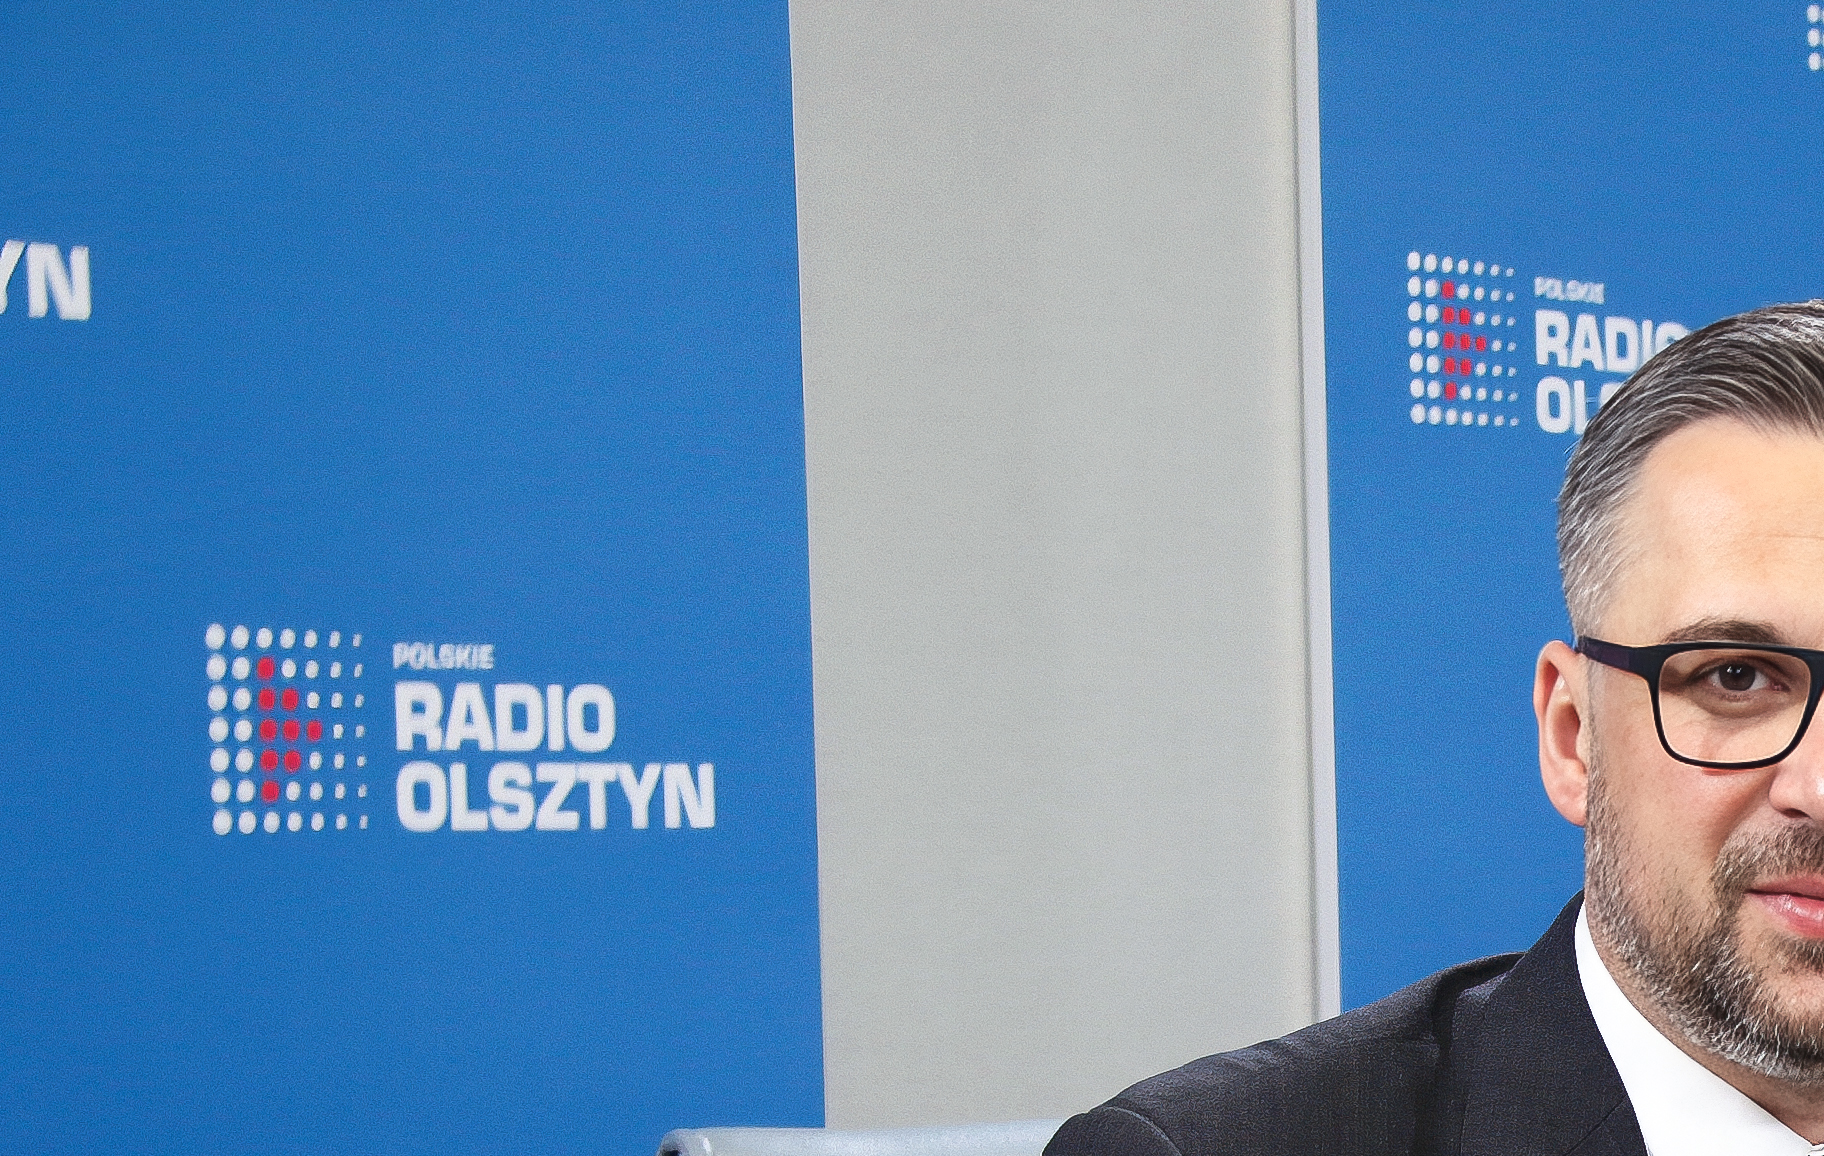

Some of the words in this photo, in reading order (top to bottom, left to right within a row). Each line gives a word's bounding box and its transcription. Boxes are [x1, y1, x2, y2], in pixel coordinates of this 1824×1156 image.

[392, 643, 495, 670] POLSKIE
[394, 681, 616, 753] RADIO
[396, 761, 716, 832] OLSZTYN
